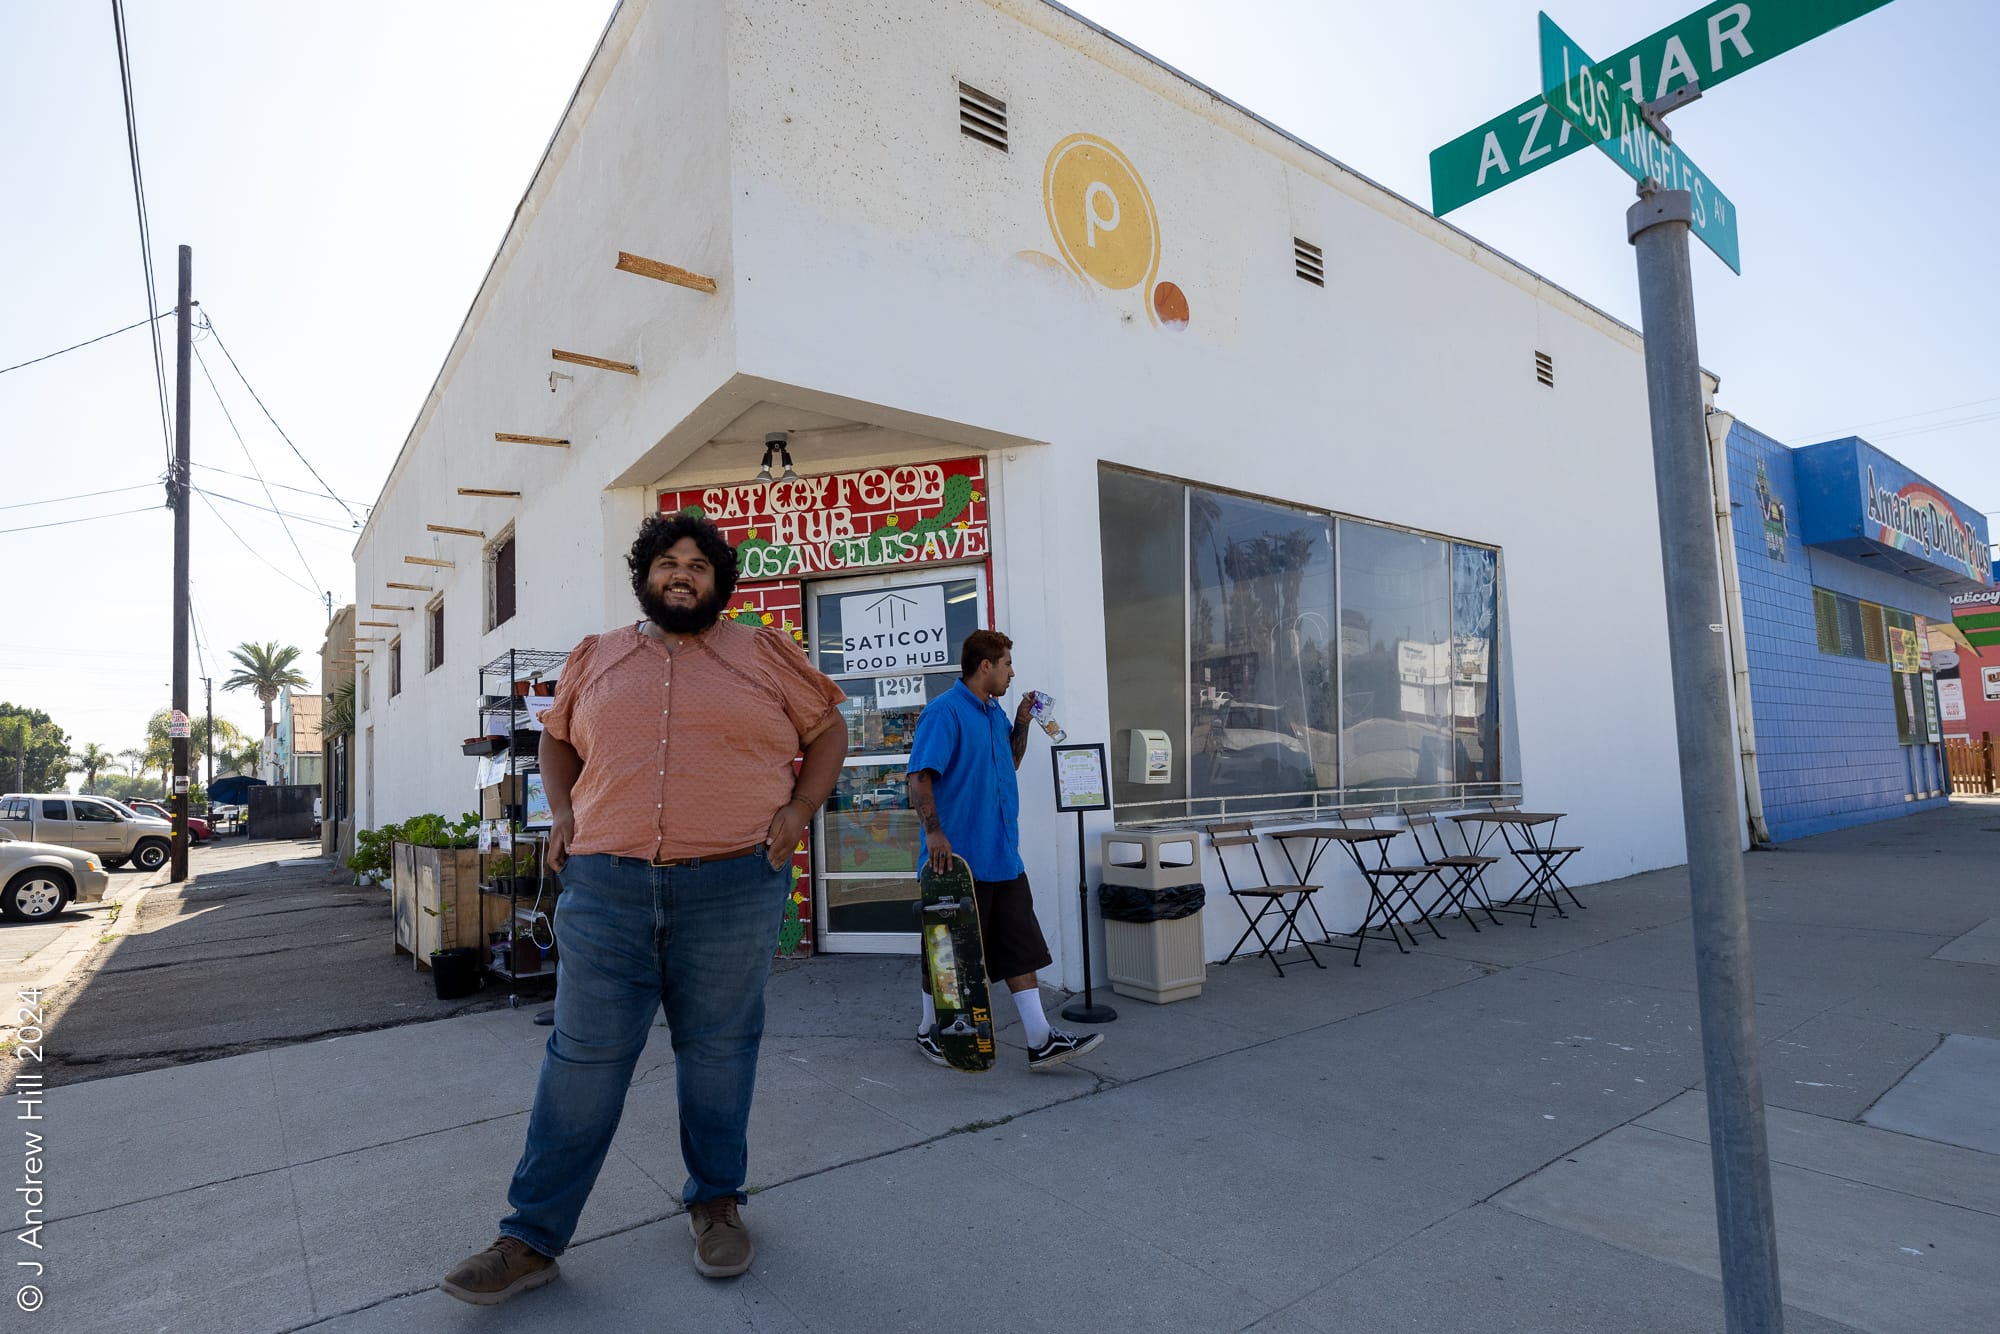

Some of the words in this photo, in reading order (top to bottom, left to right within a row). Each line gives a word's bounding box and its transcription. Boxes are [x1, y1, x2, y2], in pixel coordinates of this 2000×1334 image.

[1476, 2, 1754, 188] AZHAR
[1563, 46, 1611, 141] LOS
[1620, 103, 1706, 229] ANGELES
[1714, 196, 1725, 226] AV
[703, 476, 831, 521] SATICOY
[833, 464, 945, 507] FOOD
[771, 507, 854, 546] HUB
[1867, 463, 1931, 558] Amazing
[1927, 499, 1966, 564] Dollar
[1965, 521, 1990, 576] Plus
[782, 532, 918, 575] ANGELES
[919, 526, 985, 561] AVE
[1949, 591, 2000, 605] aticoy
[844, 627, 944, 652] SATICOY
[846, 655, 897, 671] FOOD
[906, 650, 945, 665] HUB
[878, 676, 923, 698] 1297
[972, 1007, 992, 1053] HOEY
